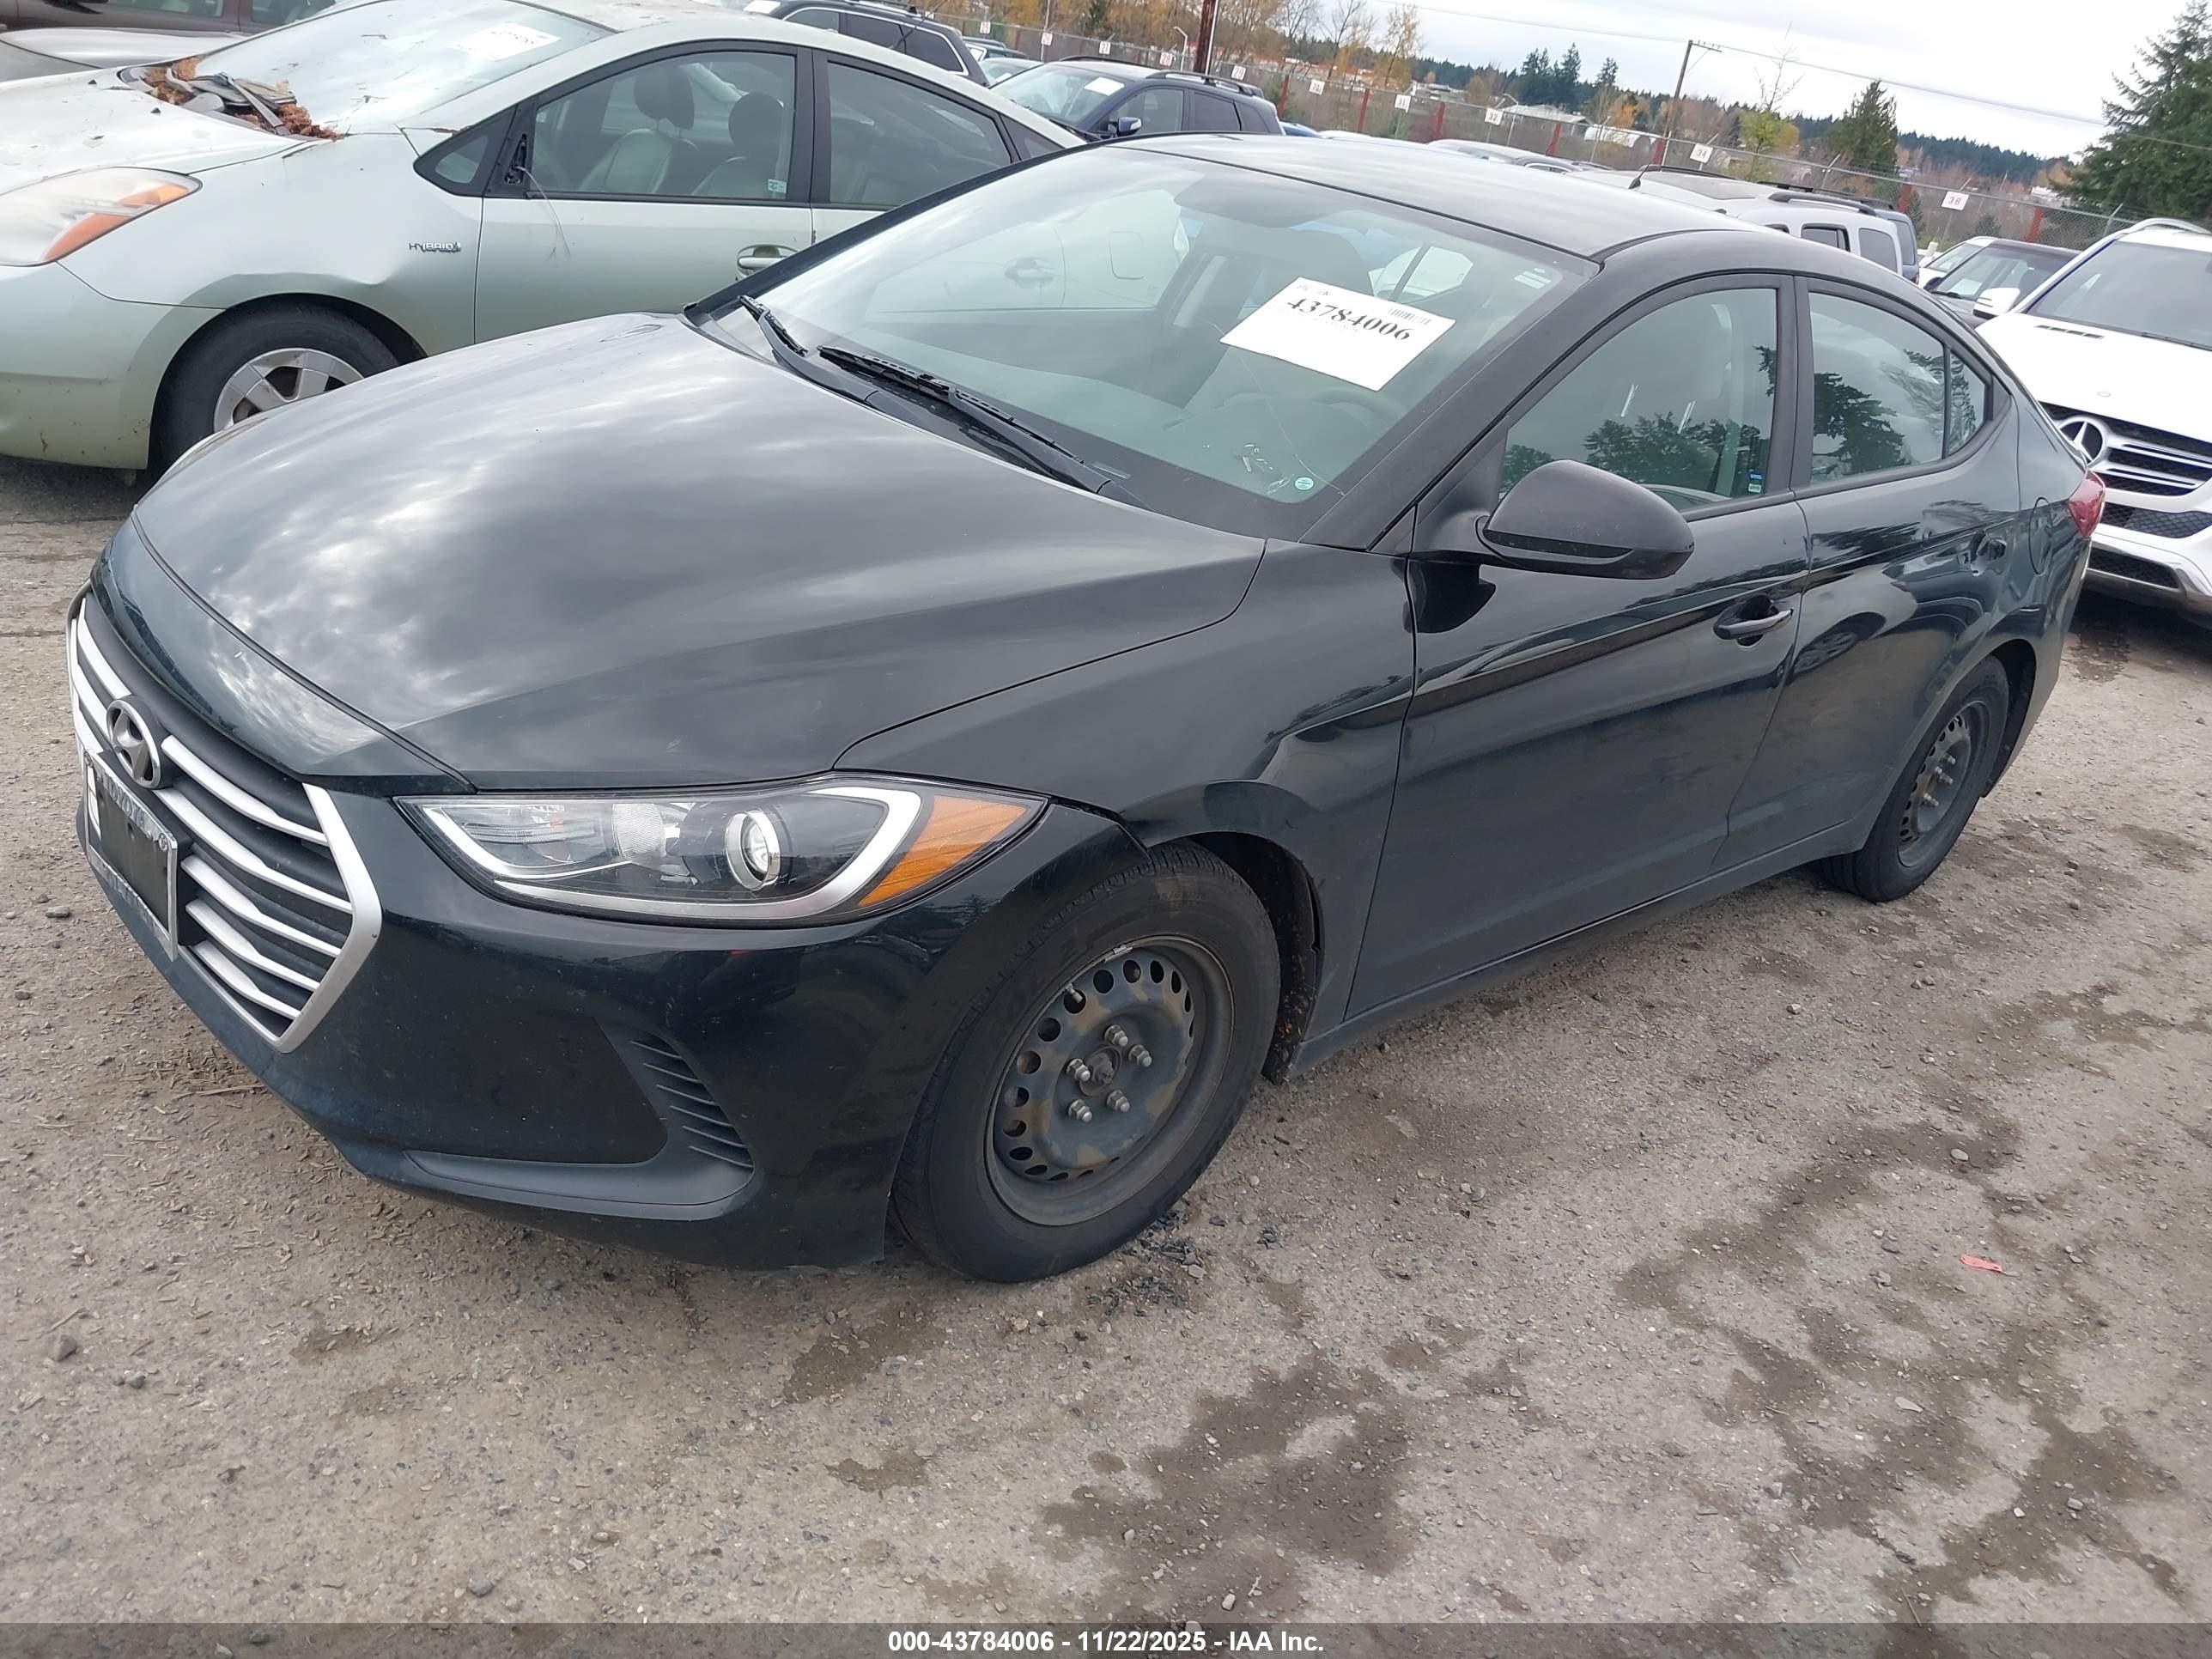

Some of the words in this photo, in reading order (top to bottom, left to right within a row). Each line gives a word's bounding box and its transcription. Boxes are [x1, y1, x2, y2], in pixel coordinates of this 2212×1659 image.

[1162, 52, 1171, 65] 28
[1948, 196, 1962, 206] 36
[408, 242, 455, 252] HYBRID
[1286, 298, 1414, 340] 43784006
